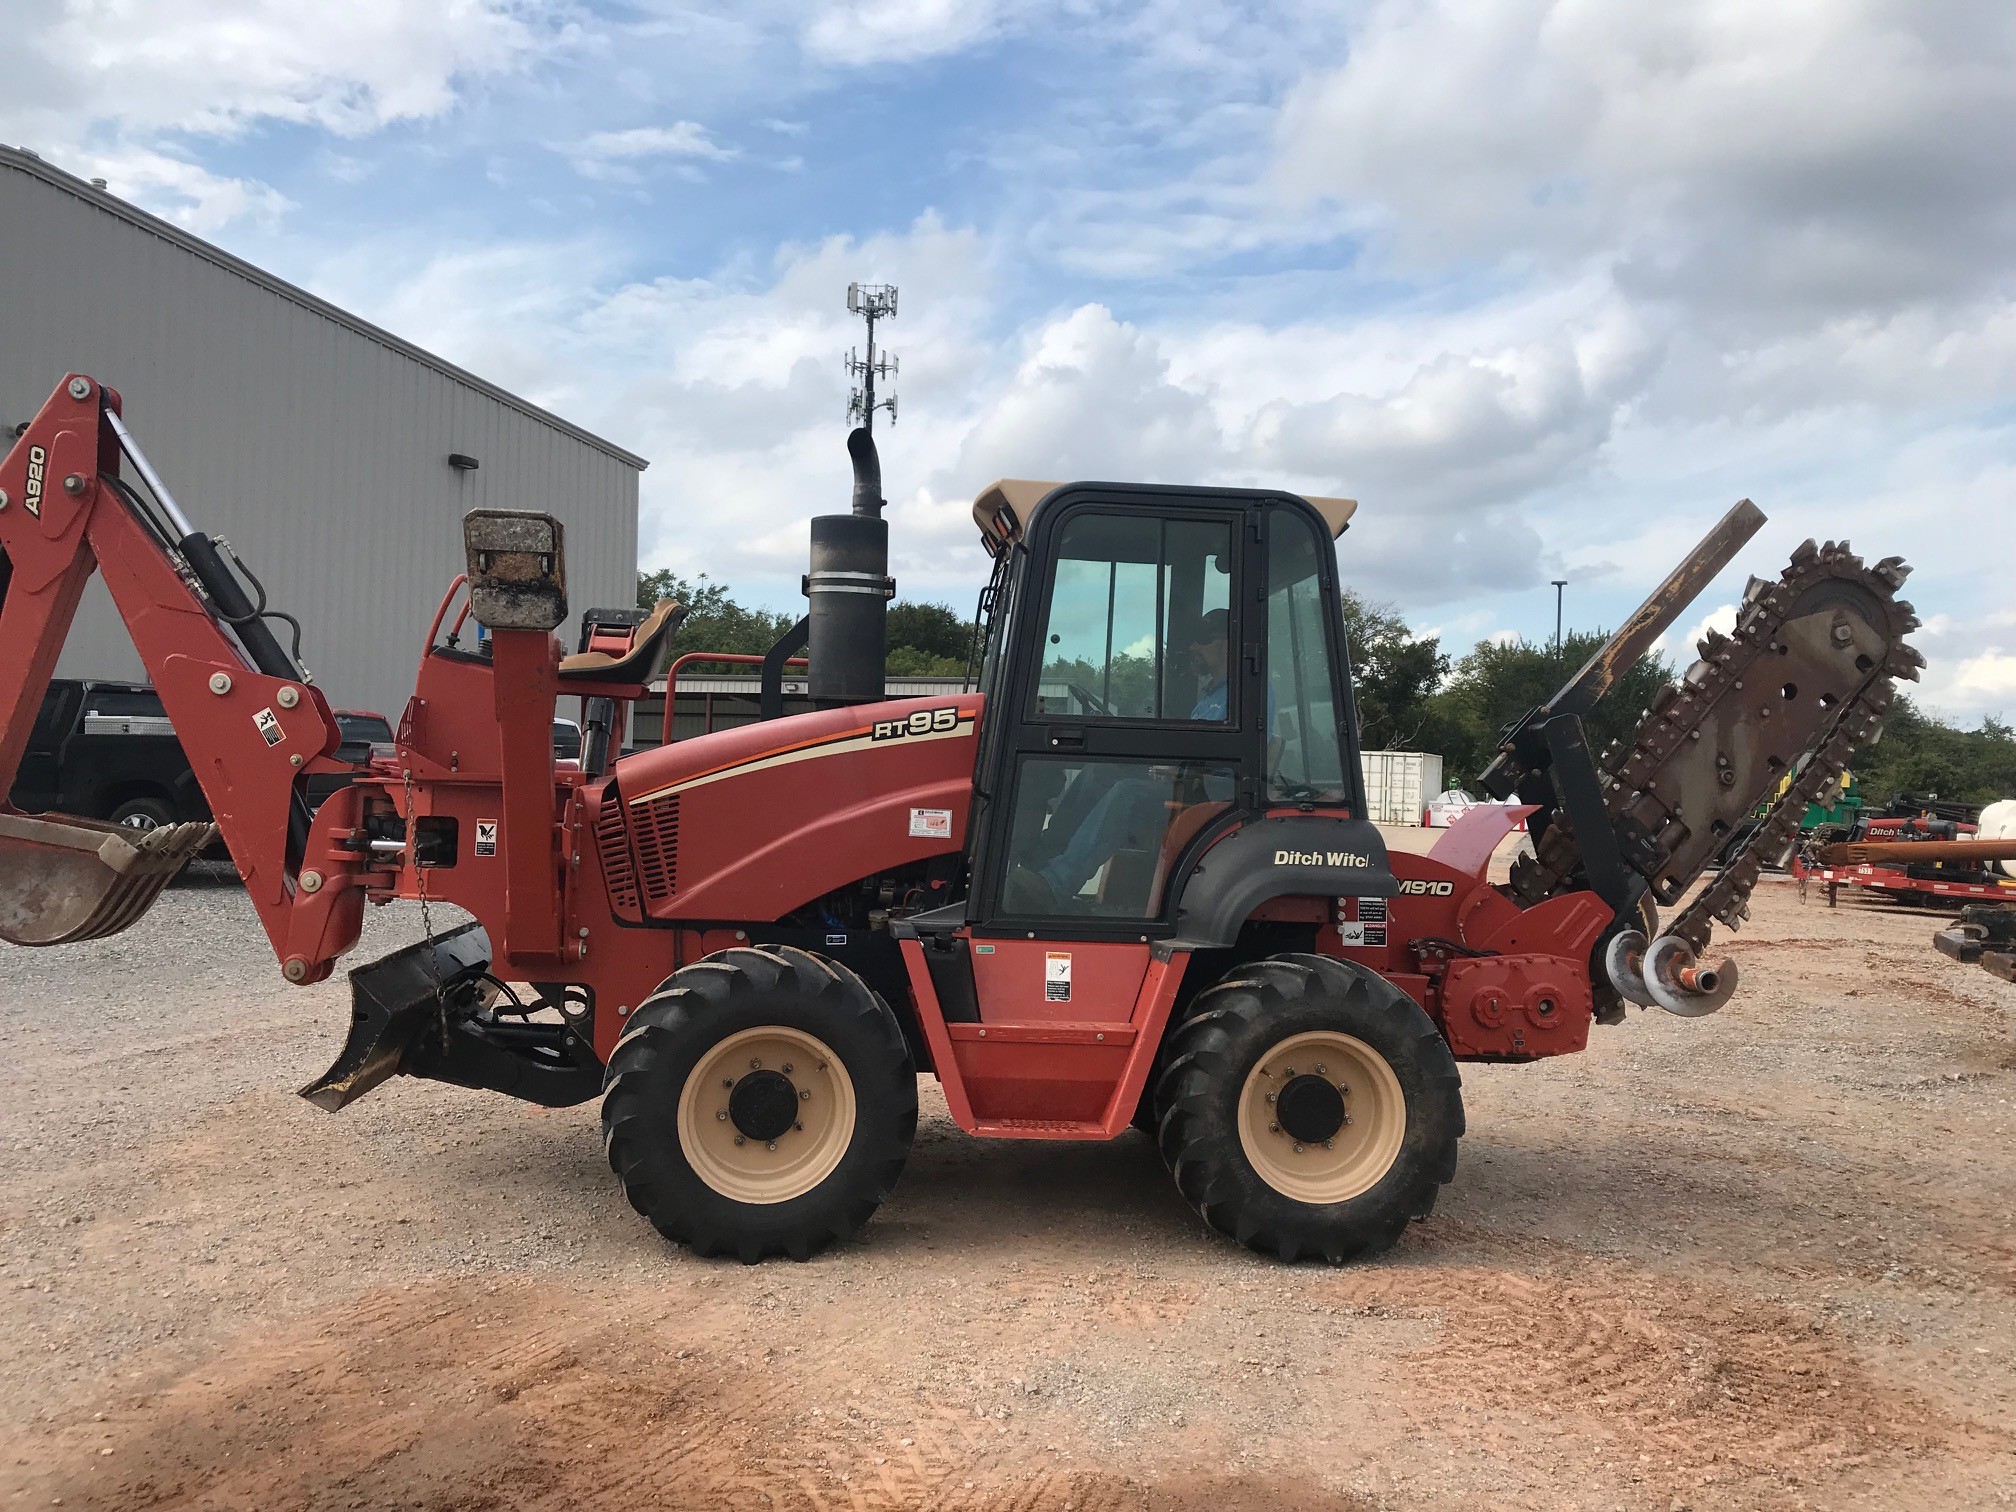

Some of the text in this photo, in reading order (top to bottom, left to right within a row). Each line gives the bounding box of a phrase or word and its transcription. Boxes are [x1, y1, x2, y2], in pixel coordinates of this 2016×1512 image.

[25, 446, 45, 516] A920
[874, 708, 956, 738] RT95
[1869, 827, 1895, 836] Ditch
[1274, 850, 1374, 868] Ditch Witc
